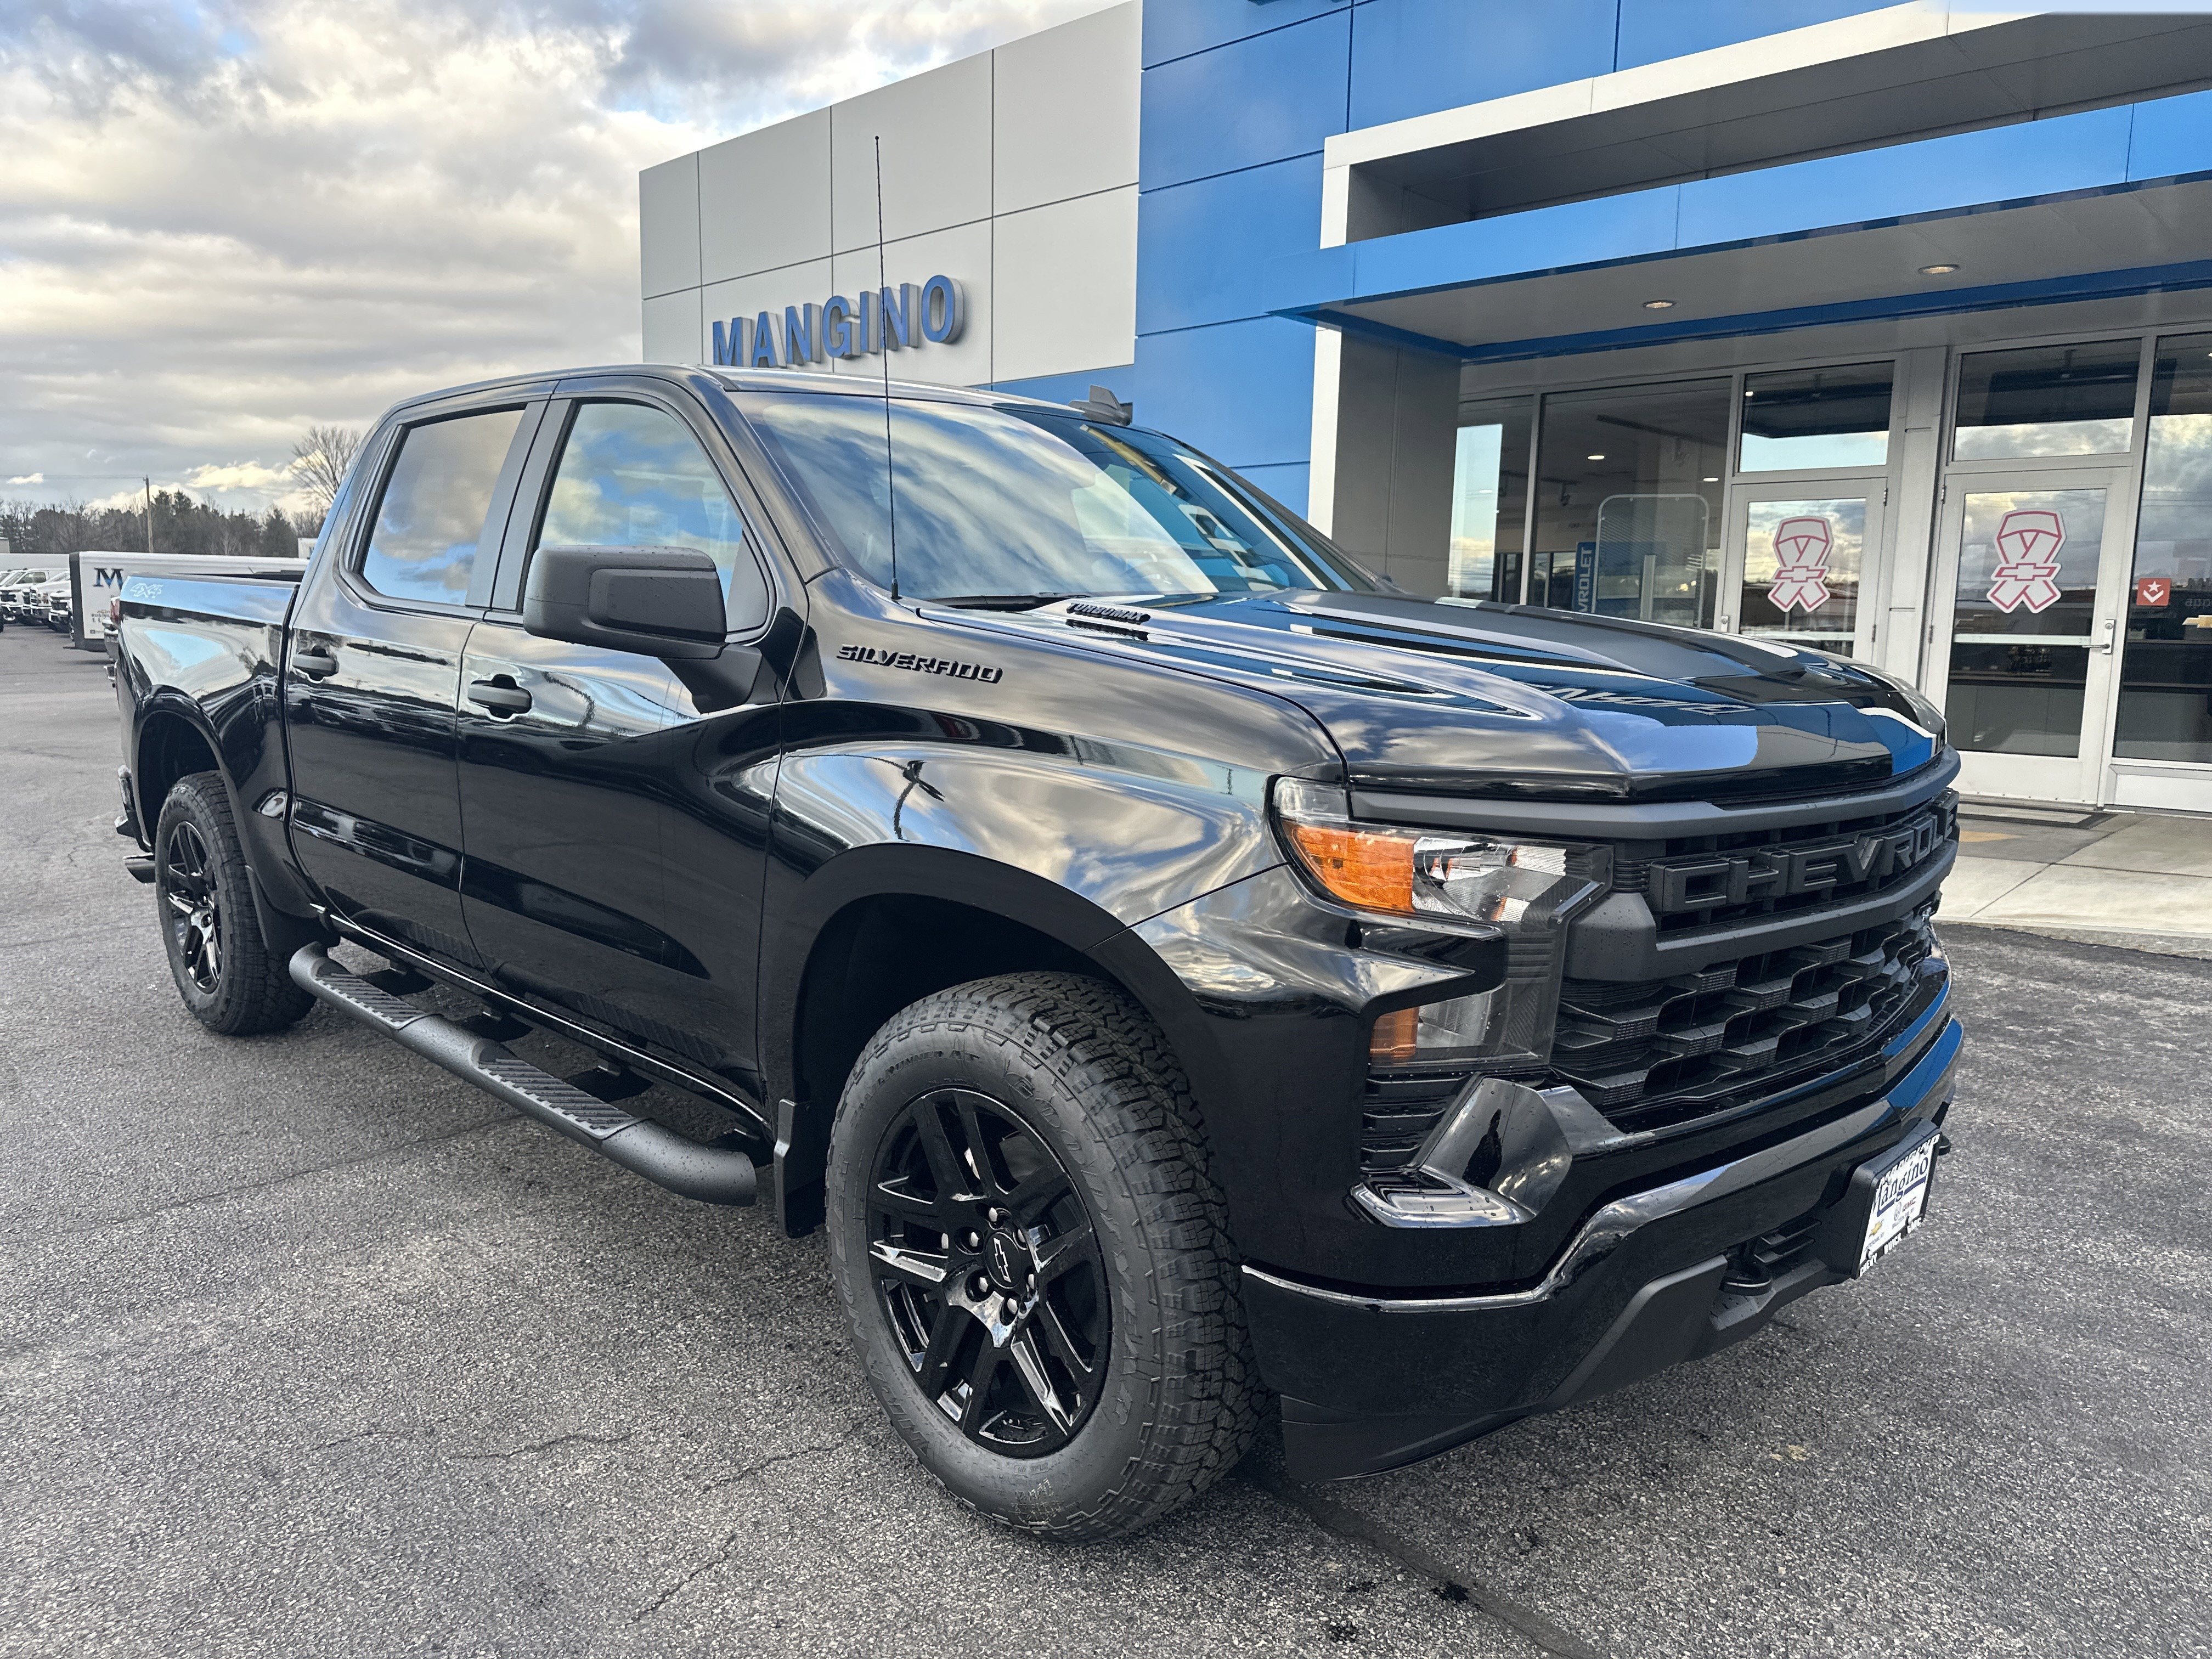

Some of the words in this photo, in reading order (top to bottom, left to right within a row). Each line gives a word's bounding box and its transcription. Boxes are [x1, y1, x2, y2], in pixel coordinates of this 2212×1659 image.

[713, 275, 962, 368] MANGINO
[1578, 547, 1593, 612] VROLET
[1066, 603, 1150, 625] TURBOMAX
[837, 644, 1003, 684] SILVERADO
[1648, 790, 1959, 913] CHEVROLE
[1884, 1232, 1901, 1254] BUICK
